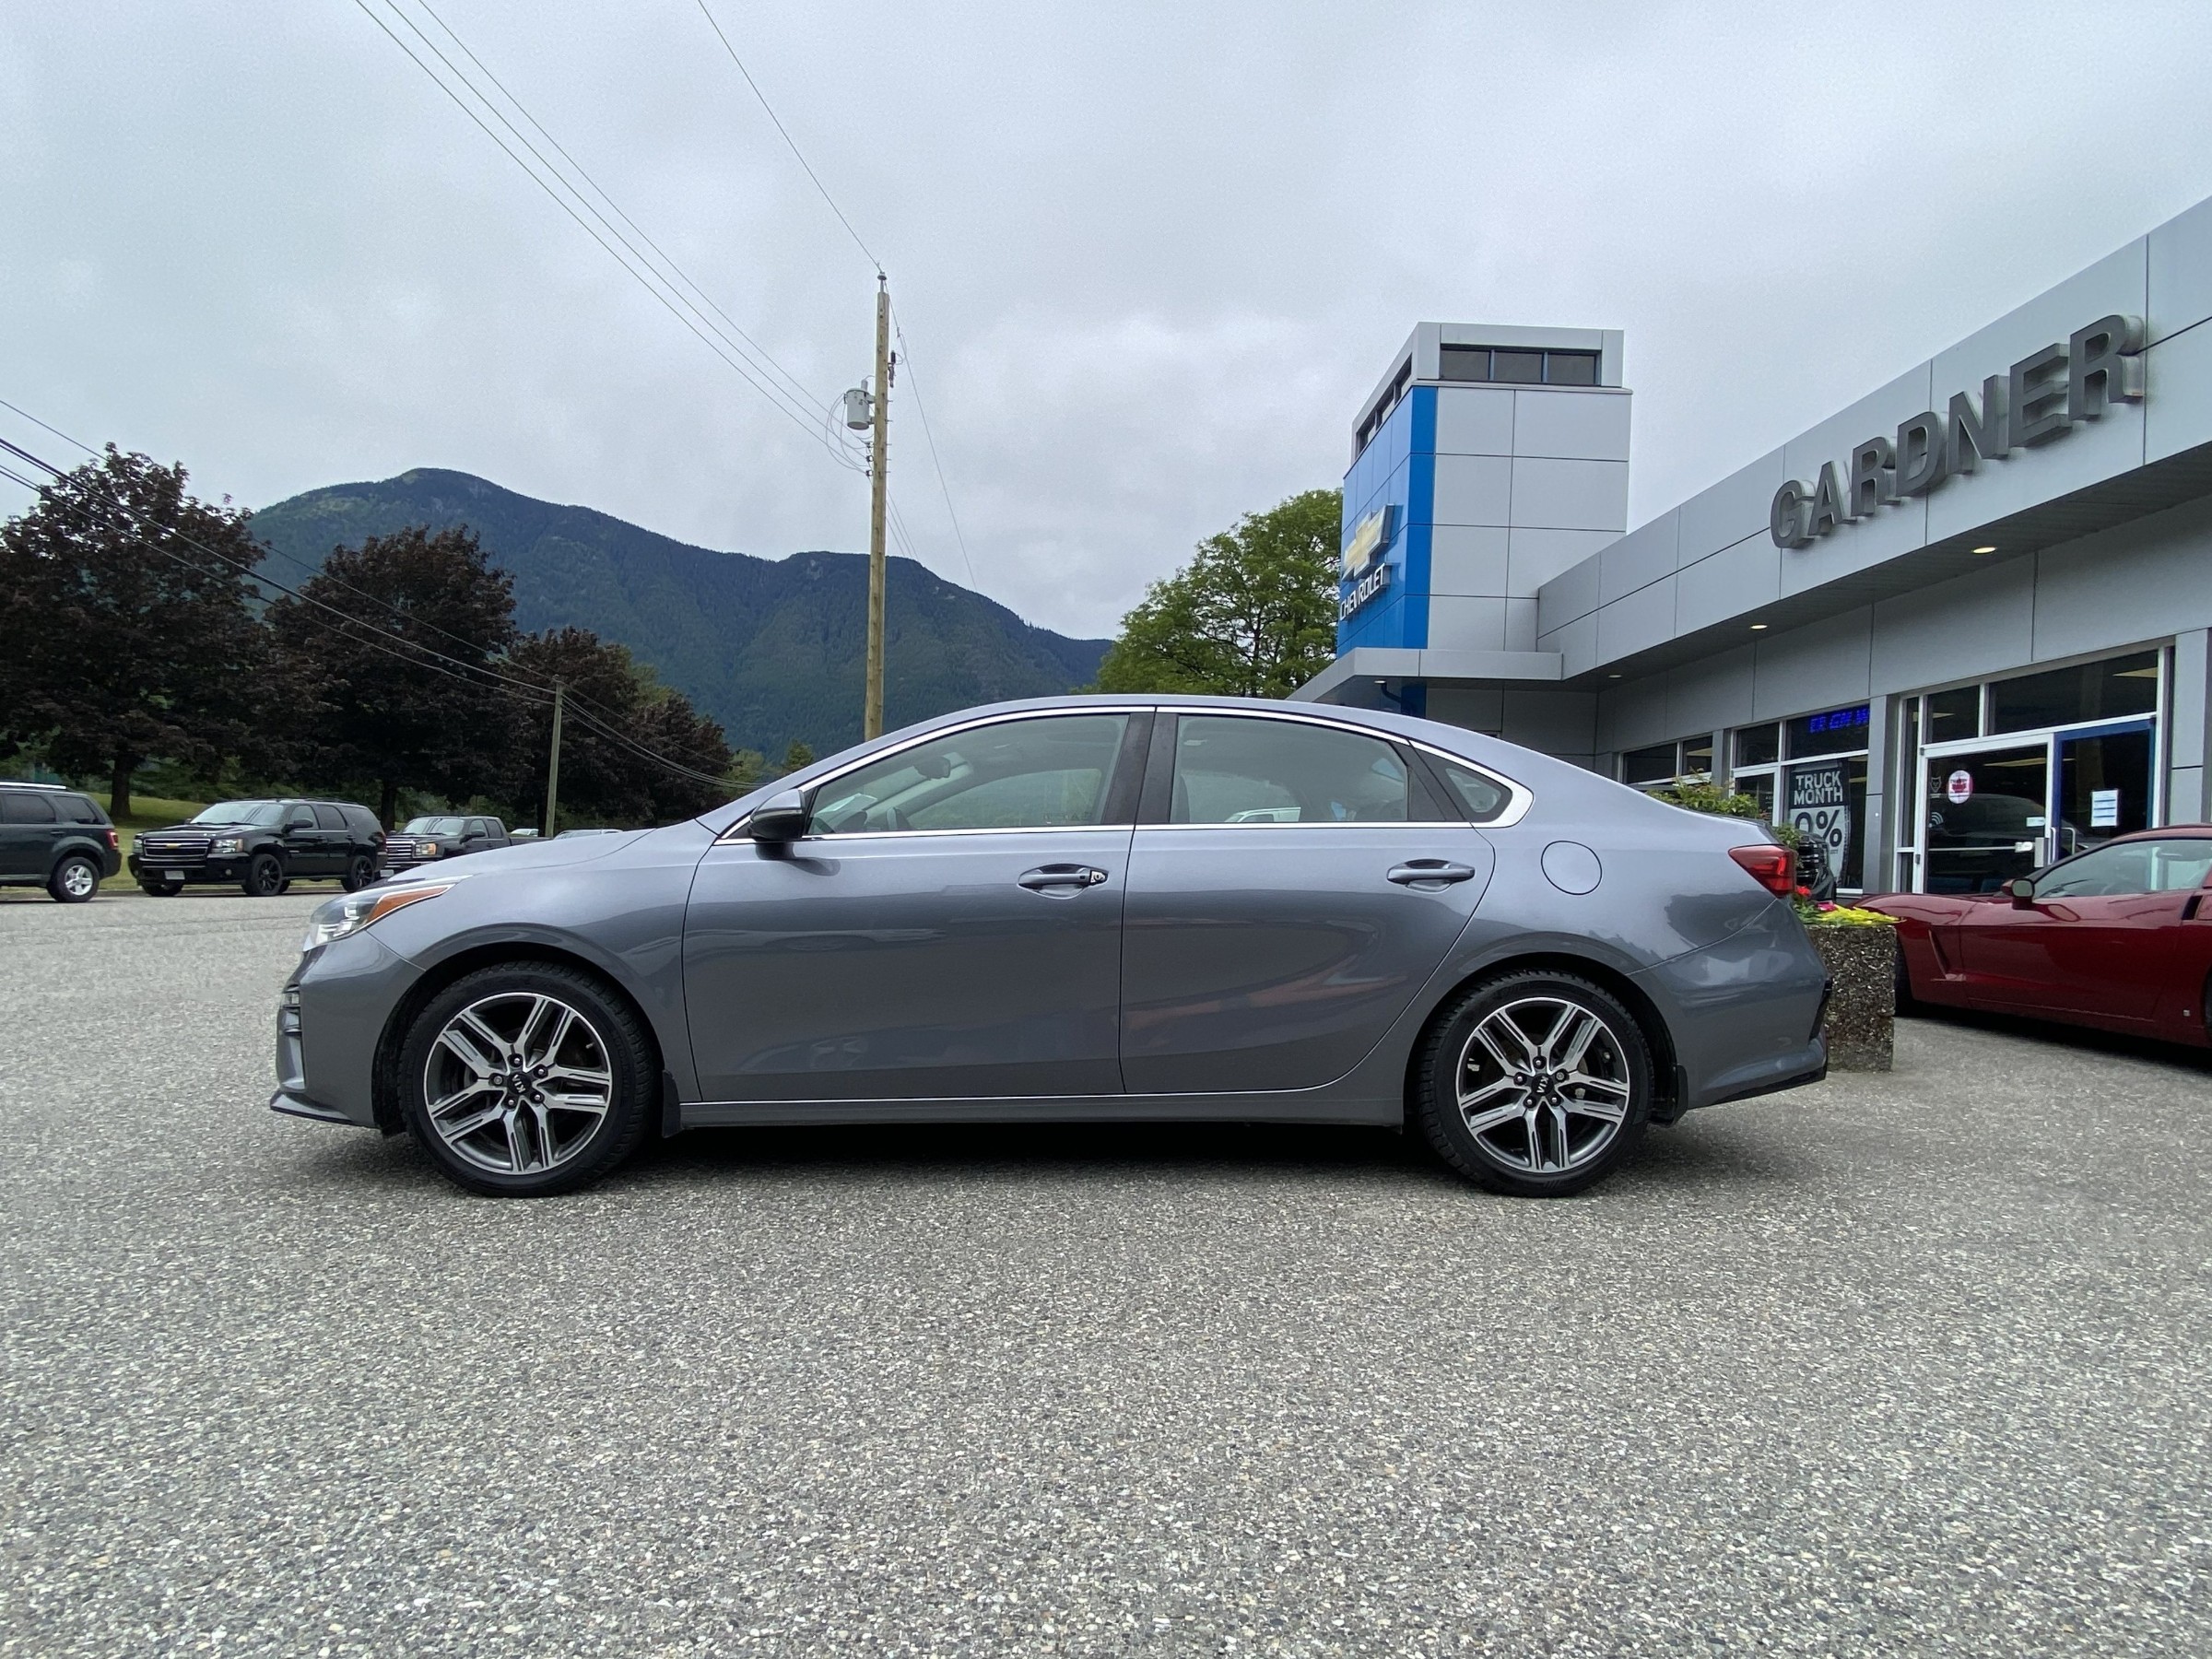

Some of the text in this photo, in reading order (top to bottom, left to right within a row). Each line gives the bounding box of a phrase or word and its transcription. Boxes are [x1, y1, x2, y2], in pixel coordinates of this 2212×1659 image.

[1770, 313, 2144, 549] GARDNER
[1339, 562, 1385, 621] CHEVROLET
[1795, 771, 1841, 791] TRUCK
[1794, 786, 1843, 806] MONTH
[512, 1074, 525, 1093] KIA
[1536, 1076, 1548, 1093] KIA
